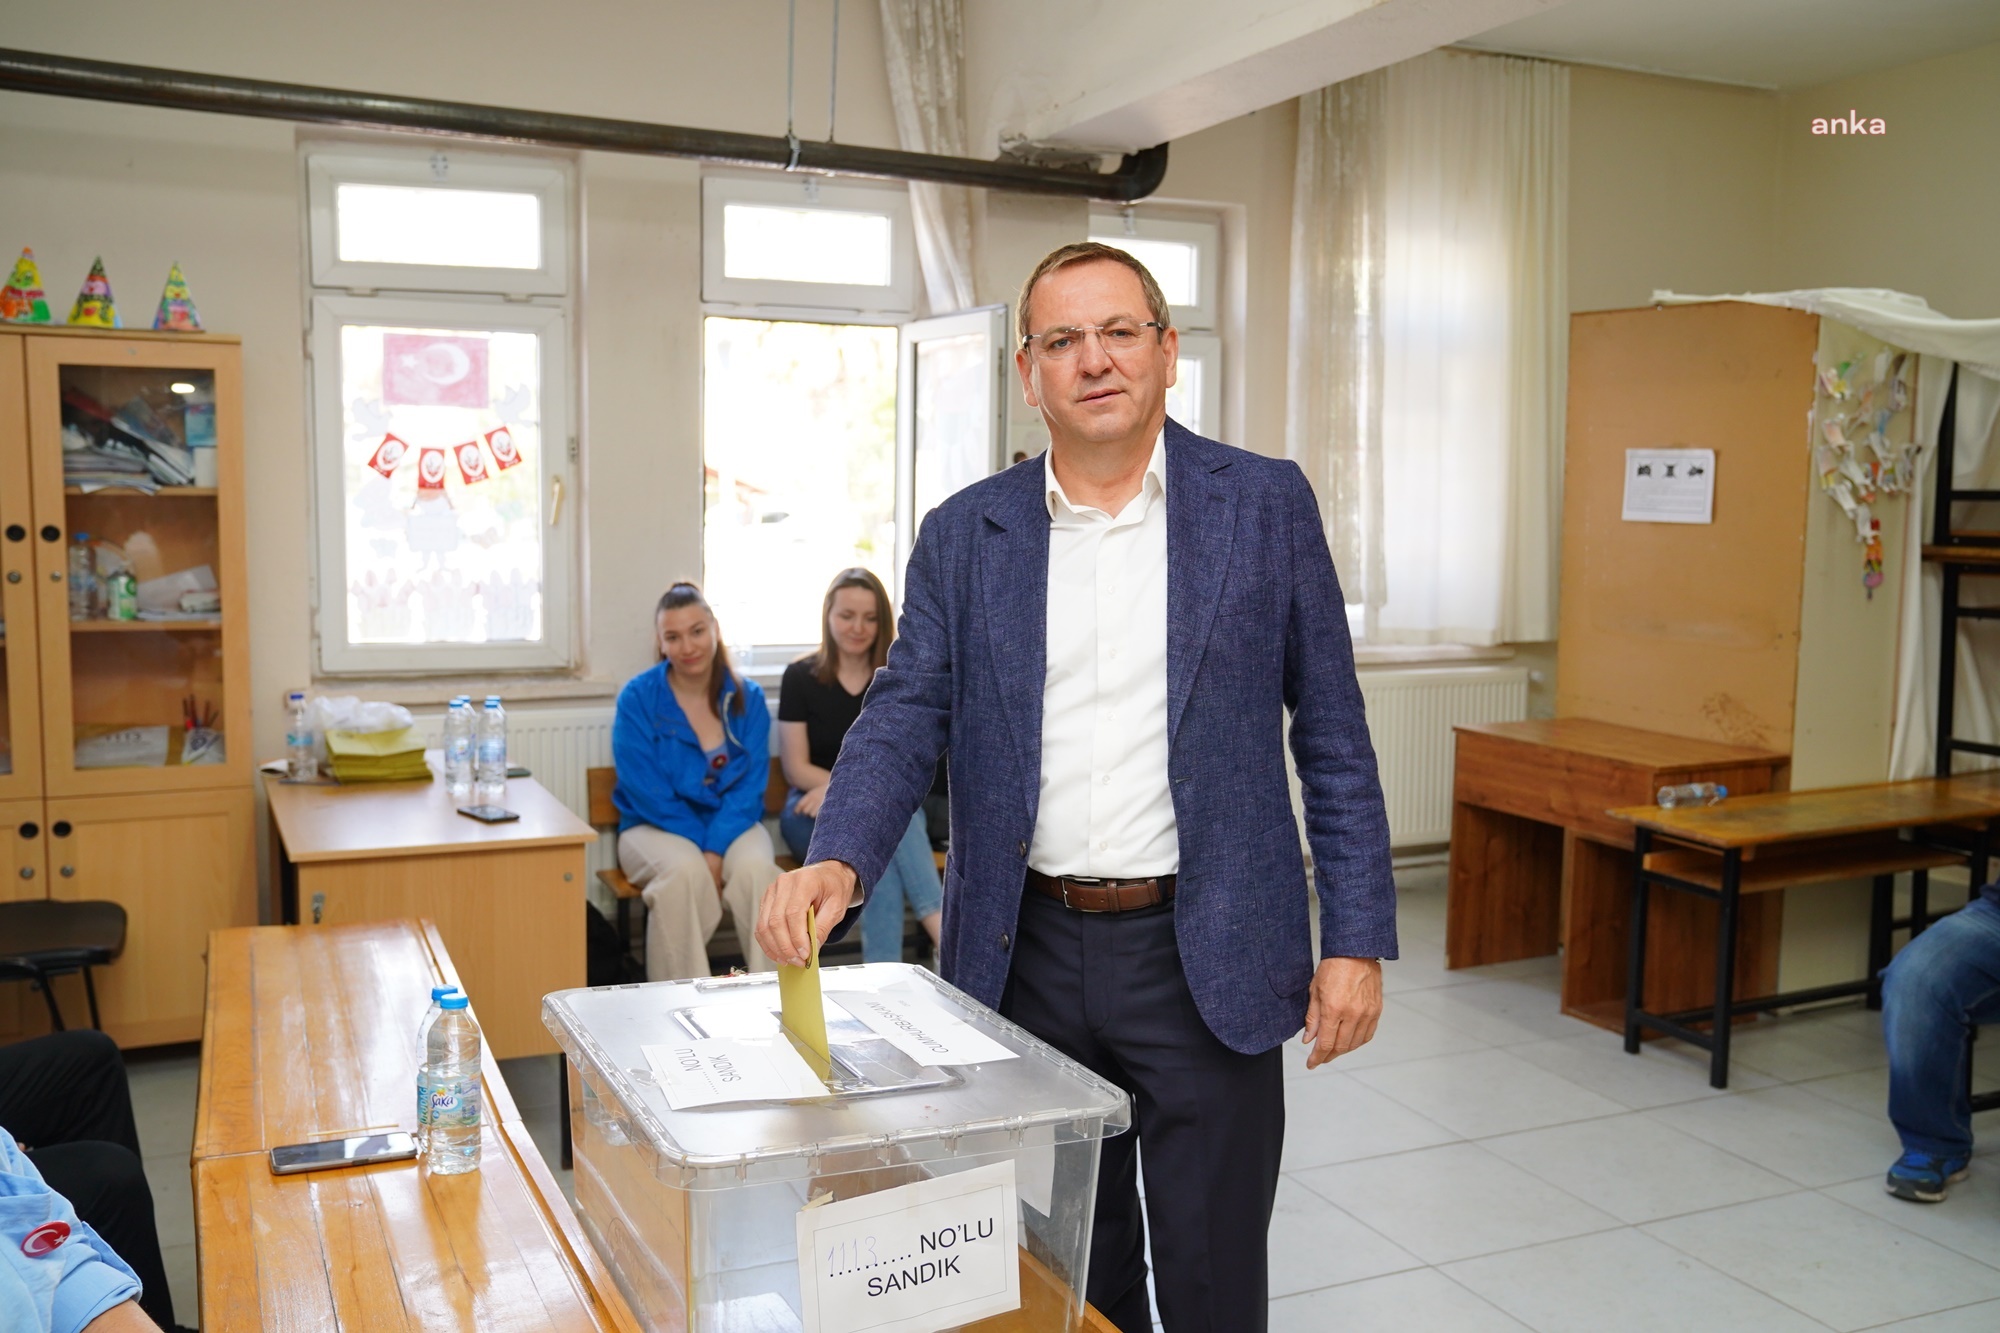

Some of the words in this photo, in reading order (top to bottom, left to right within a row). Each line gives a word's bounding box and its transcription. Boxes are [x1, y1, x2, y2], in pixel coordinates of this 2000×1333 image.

[706, 1054, 742, 1083] SANDIK
[920, 1217, 993, 1254] NO'LU
[867, 1255, 961, 1297] SANDIK
